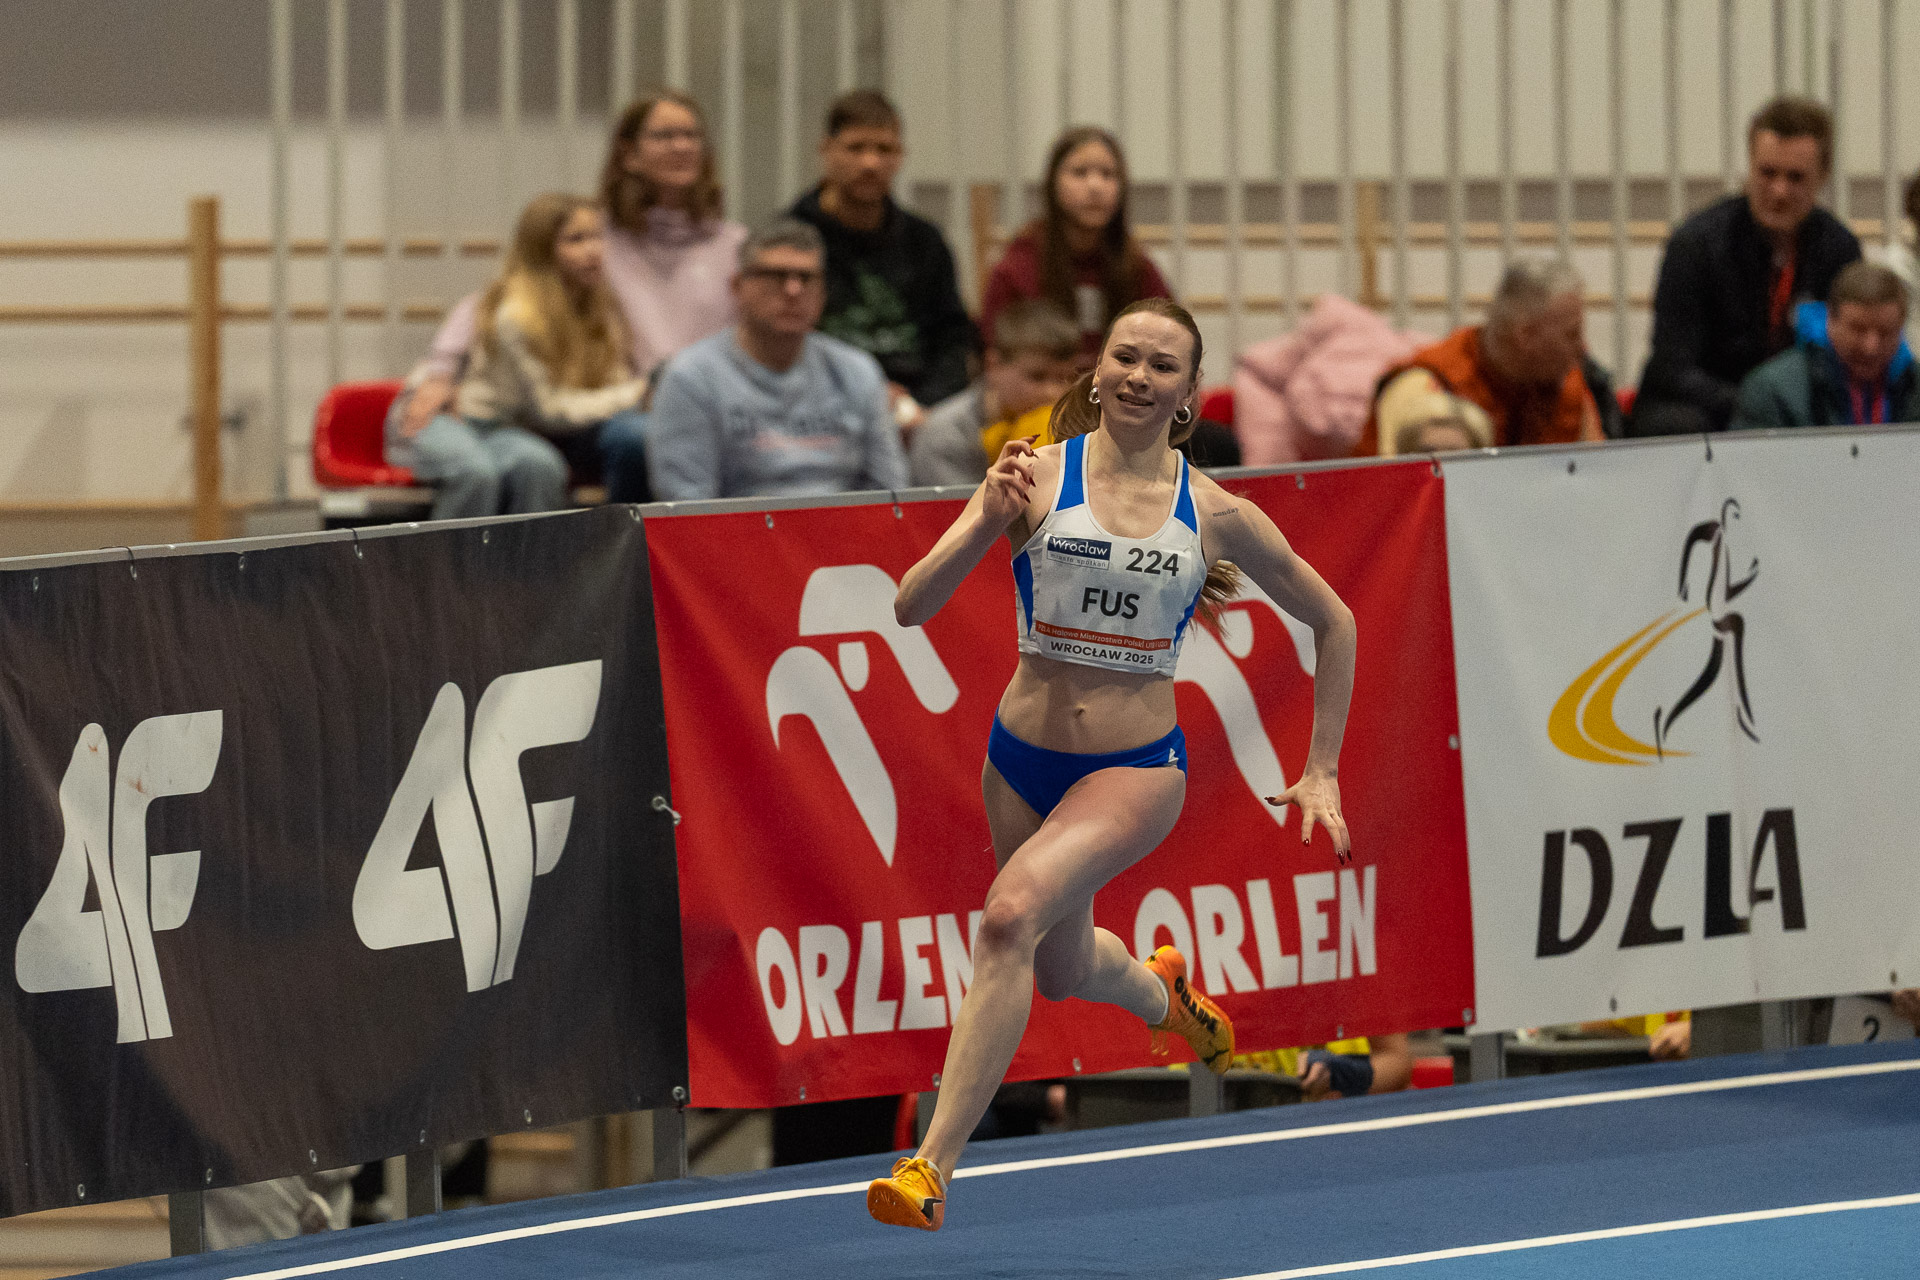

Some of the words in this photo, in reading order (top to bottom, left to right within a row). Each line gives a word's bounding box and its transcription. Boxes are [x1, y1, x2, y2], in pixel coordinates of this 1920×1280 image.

[1052, 537, 1108, 556] Wrocław
[1126, 547, 1179, 577] 224
[1052, 627, 1079, 637] Halowe
[1080, 632, 1123, 645] Mistrzostwa
[1123, 638, 1145, 648] Polski
[1081, 587, 1140, 620] FUS
[1050, 641, 1122, 661] WROCŁAW
[1124, 651, 1154, 664] 2025
[352, 659, 602, 992] 4F
[15, 710, 222, 1043] 4F
[1536, 807, 1807, 959] DZLA
[1133, 864, 1377, 996] ORLEN
[756, 910, 985, 1046] ORLEN
